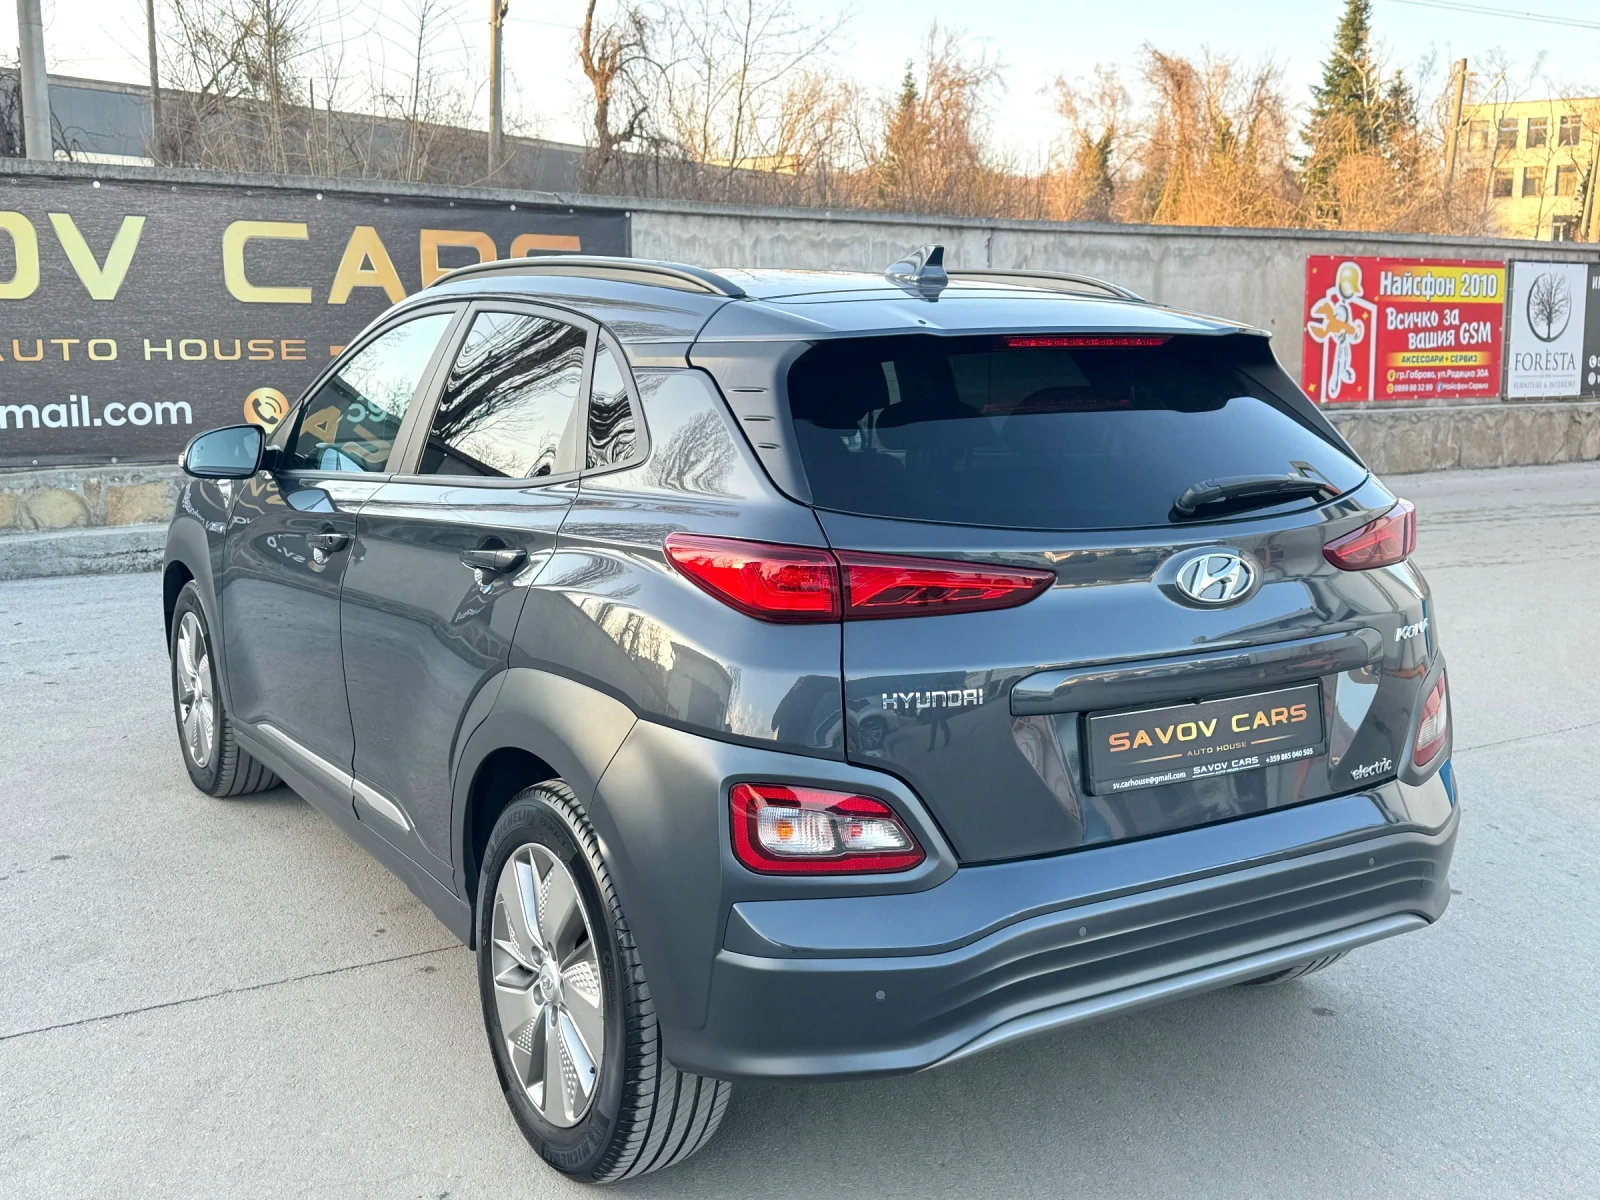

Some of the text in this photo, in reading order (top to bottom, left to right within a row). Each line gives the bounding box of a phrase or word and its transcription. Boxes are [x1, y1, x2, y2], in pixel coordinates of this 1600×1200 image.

[222, 220, 581, 304] CAR
[1380, 271, 1497, 301] Найсфон 2010
[1386, 307, 1460, 330] Всичко за
[1408, 321, 1492, 349] вашия GSM
[0, 338, 307, 362] UTO HOUSE
[1401, 354, 1478, 364] АКСЕСОАРИ СЕРВИЗ
[1395, 617, 1429, 642] KON
[882, 688, 984, 710] HYUNDAI
[1108, 703, 1308, 753] SAVOV CARS
[1187, 741, 1248, 757] AUTO HOUSE
[1265, 753, 1281, 763] +359
[1193, 761, 1228, 775] SAVOV
[1231, 756, 1260, 768] CARS
[1350, 757, 1392, 780] electric
[1112, 770, 1187, 790] sv.carhouse@gmail.com
